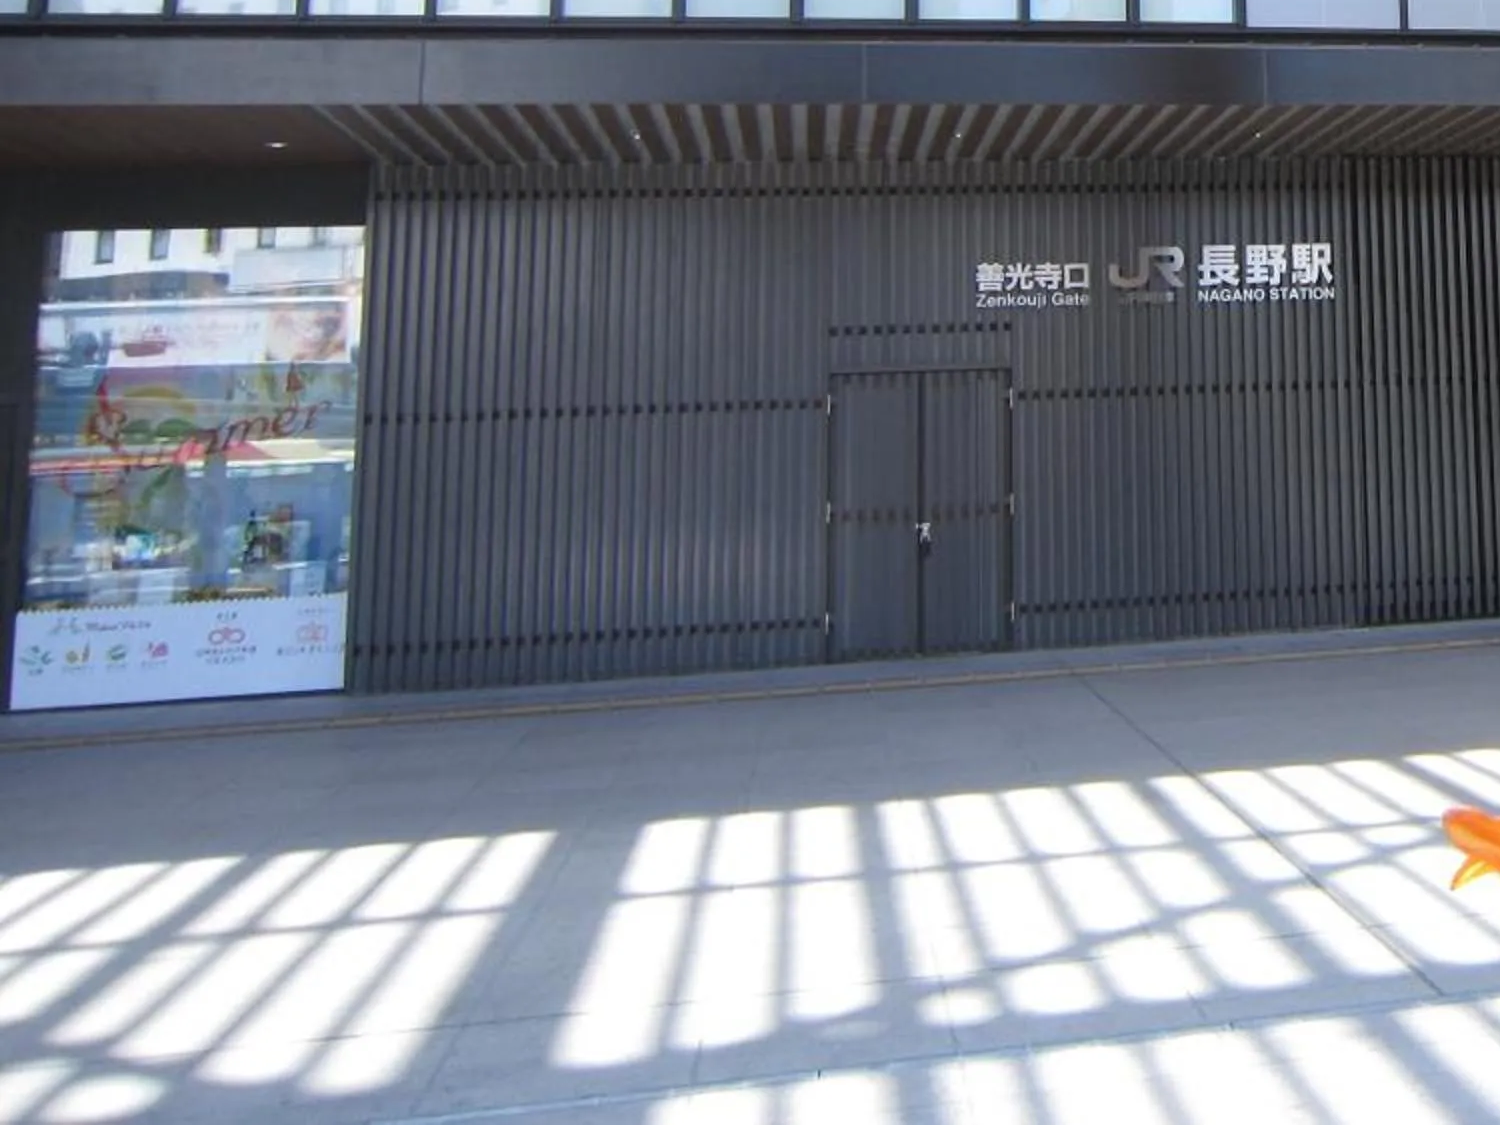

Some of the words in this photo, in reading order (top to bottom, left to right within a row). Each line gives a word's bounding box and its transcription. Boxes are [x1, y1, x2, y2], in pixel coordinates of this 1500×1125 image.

[975, 262, 1090, 291] 善光寺口
[1109, 246, 1185, 288] JR
[1197, 242, 1333, 287] 長野駅
[975, 293, 1047, 308] Zenkouji
[1051, 291, 1090, 306] Gate
[1197, 288, 1265, 302] NAGANO
[1269, 286, 1335, 300] STATION
